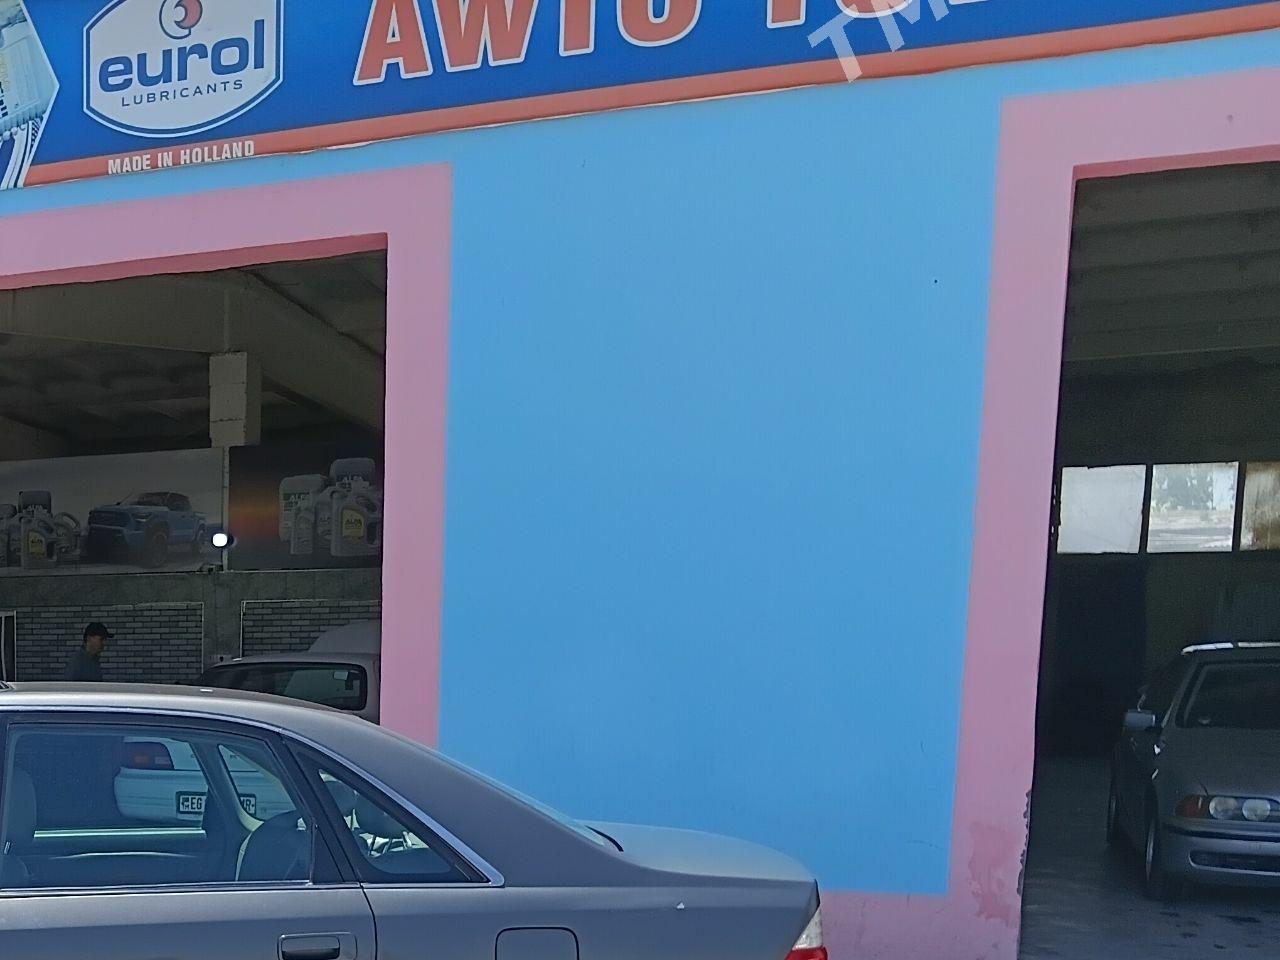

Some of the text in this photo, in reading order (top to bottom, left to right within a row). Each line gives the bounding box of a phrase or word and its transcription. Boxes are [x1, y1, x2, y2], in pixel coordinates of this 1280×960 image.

[99, 19, 264, 92] eurol
[122, 79, 243, 107] LUBRICANTS
[108, 141, 255, 175] MADE IN HOLLAND
